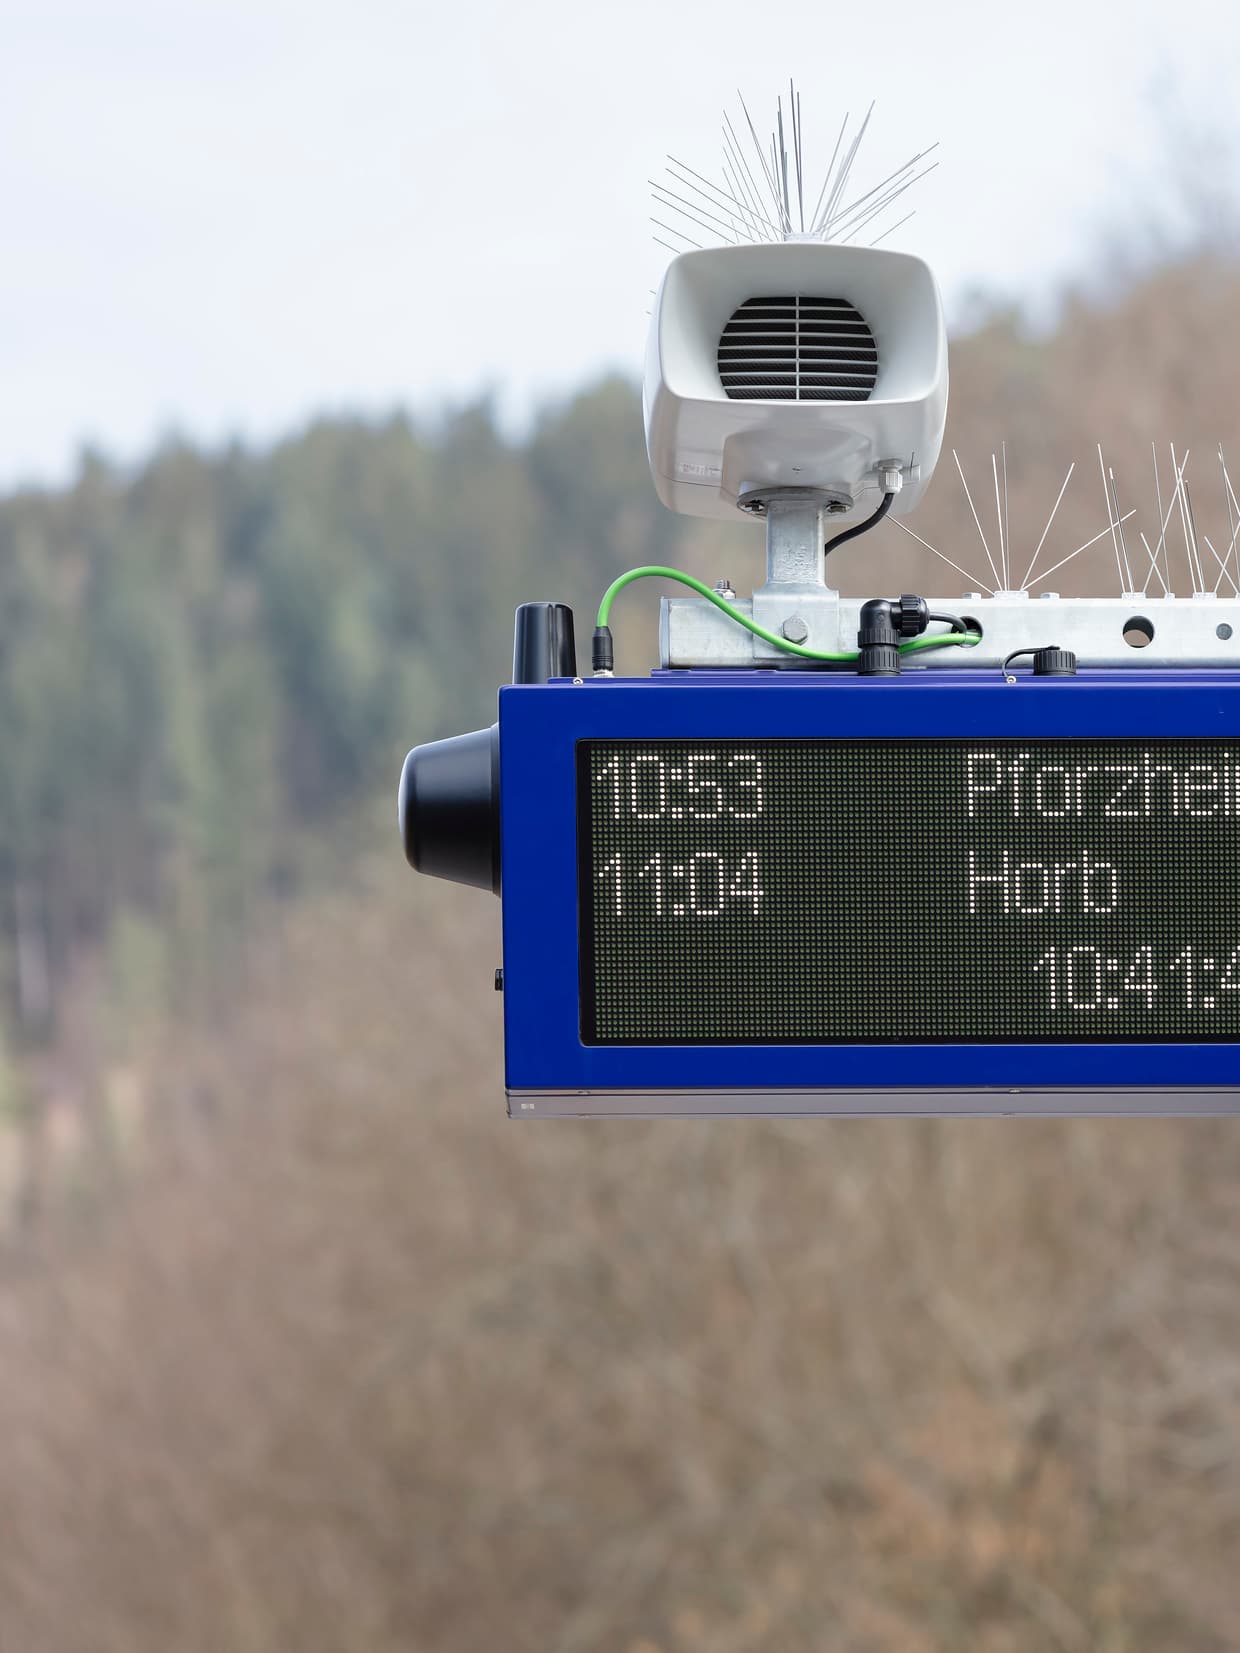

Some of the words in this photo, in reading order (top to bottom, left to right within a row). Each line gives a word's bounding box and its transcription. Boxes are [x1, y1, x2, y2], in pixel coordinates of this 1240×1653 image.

[596, 755, 763, 819] 10:53
[598, 851, 765, 916] 11:04
[968, 849, 1118, 915] Horb
